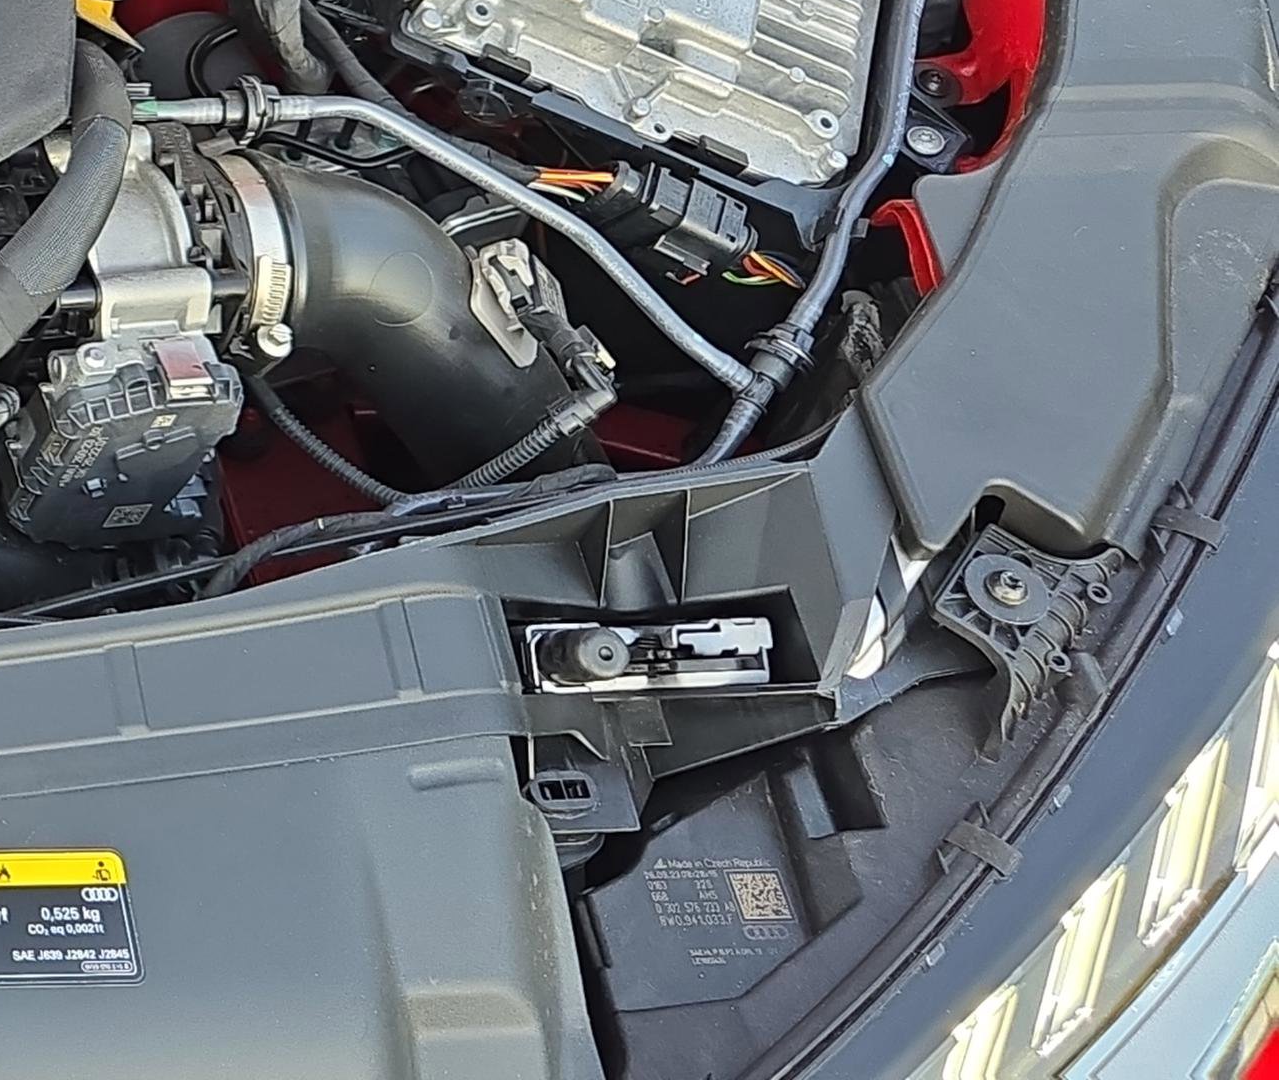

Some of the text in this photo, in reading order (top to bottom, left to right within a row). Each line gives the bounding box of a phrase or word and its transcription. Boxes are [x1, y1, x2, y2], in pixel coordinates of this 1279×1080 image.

[668, 858, 692, 869] Made
[704, 857, 731, 867] Czech
[40, 906, 102, 923] 0,525 kg
[50, 924, 64, 936] eq
[12, 950, 37, 963] SAE
